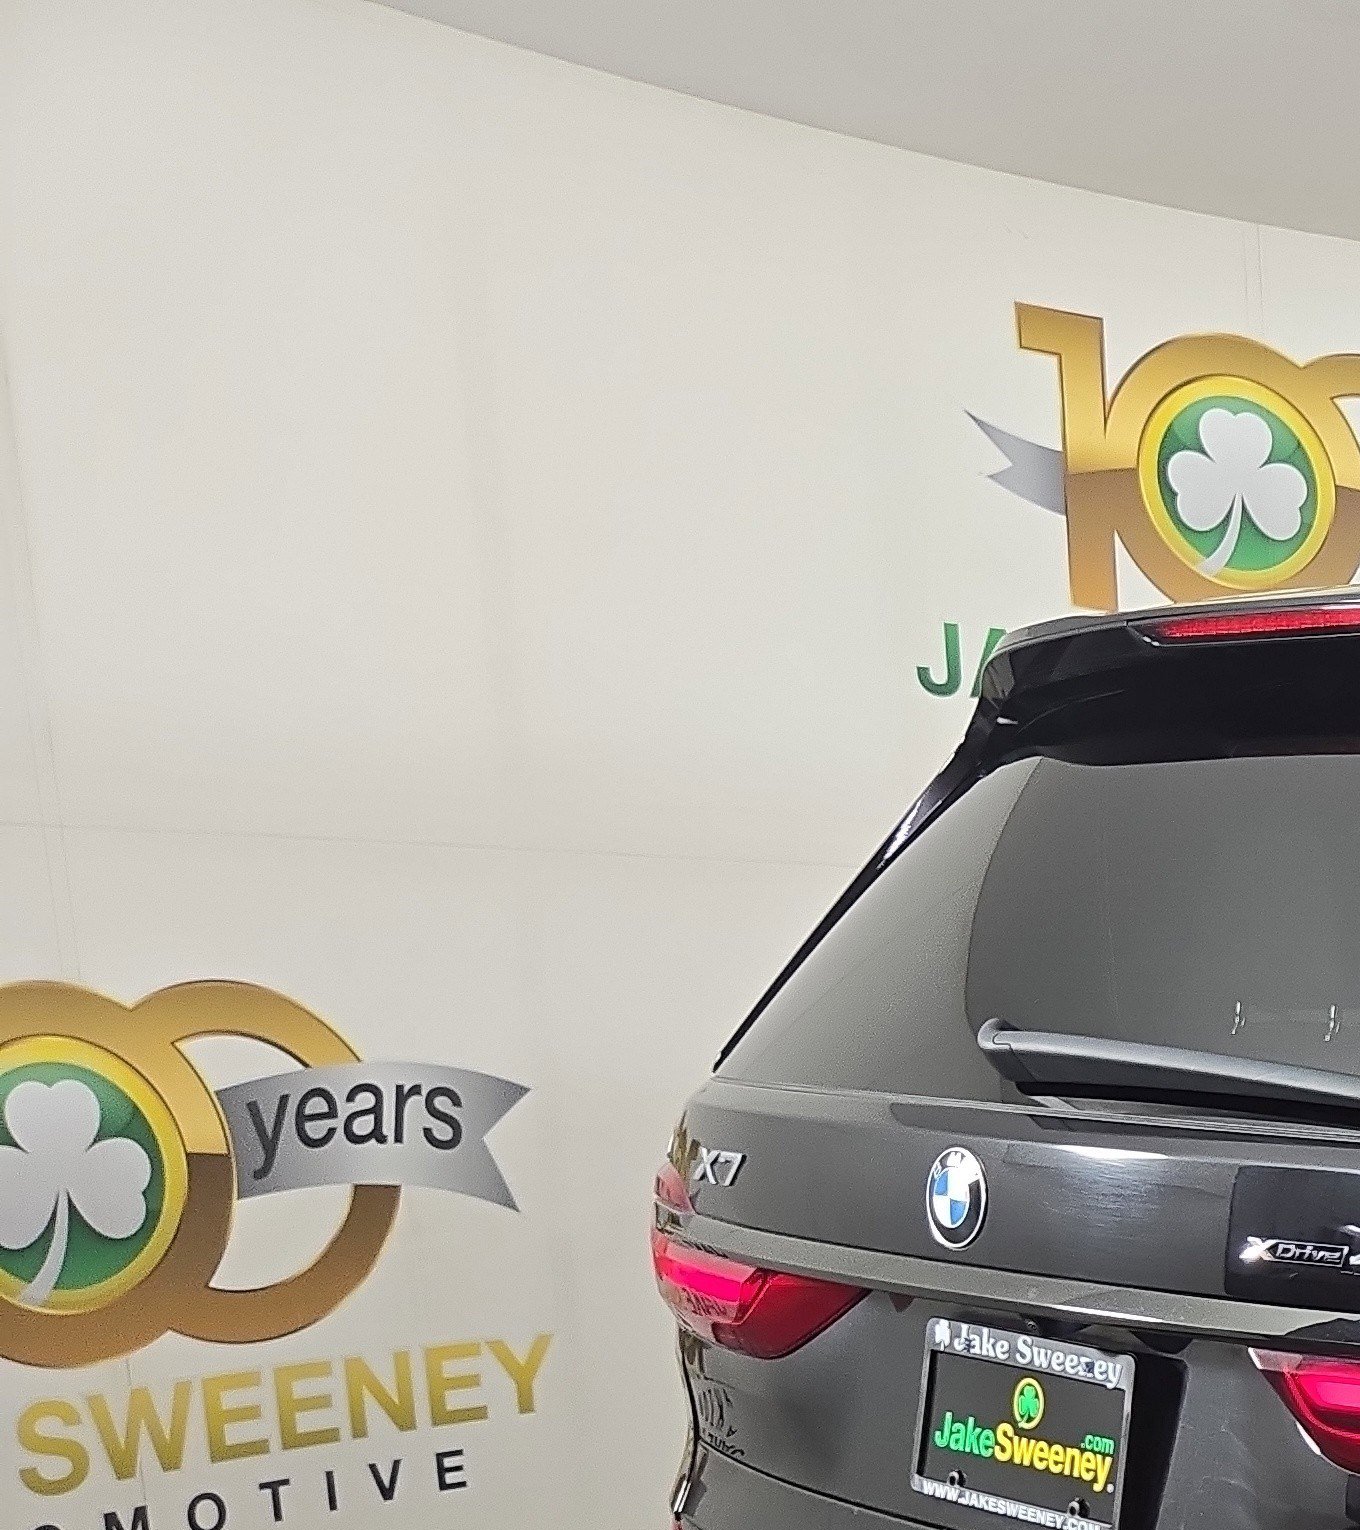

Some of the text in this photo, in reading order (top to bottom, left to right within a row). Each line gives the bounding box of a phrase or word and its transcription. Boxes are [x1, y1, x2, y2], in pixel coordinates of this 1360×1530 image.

[245, 1080, 464, 1179] years
[693, 1146, 747, 1187] X7
[953, 1322, 1123, 1390] Jake Sweeney
[16, 1333, 554, 1497] SWEENEY
